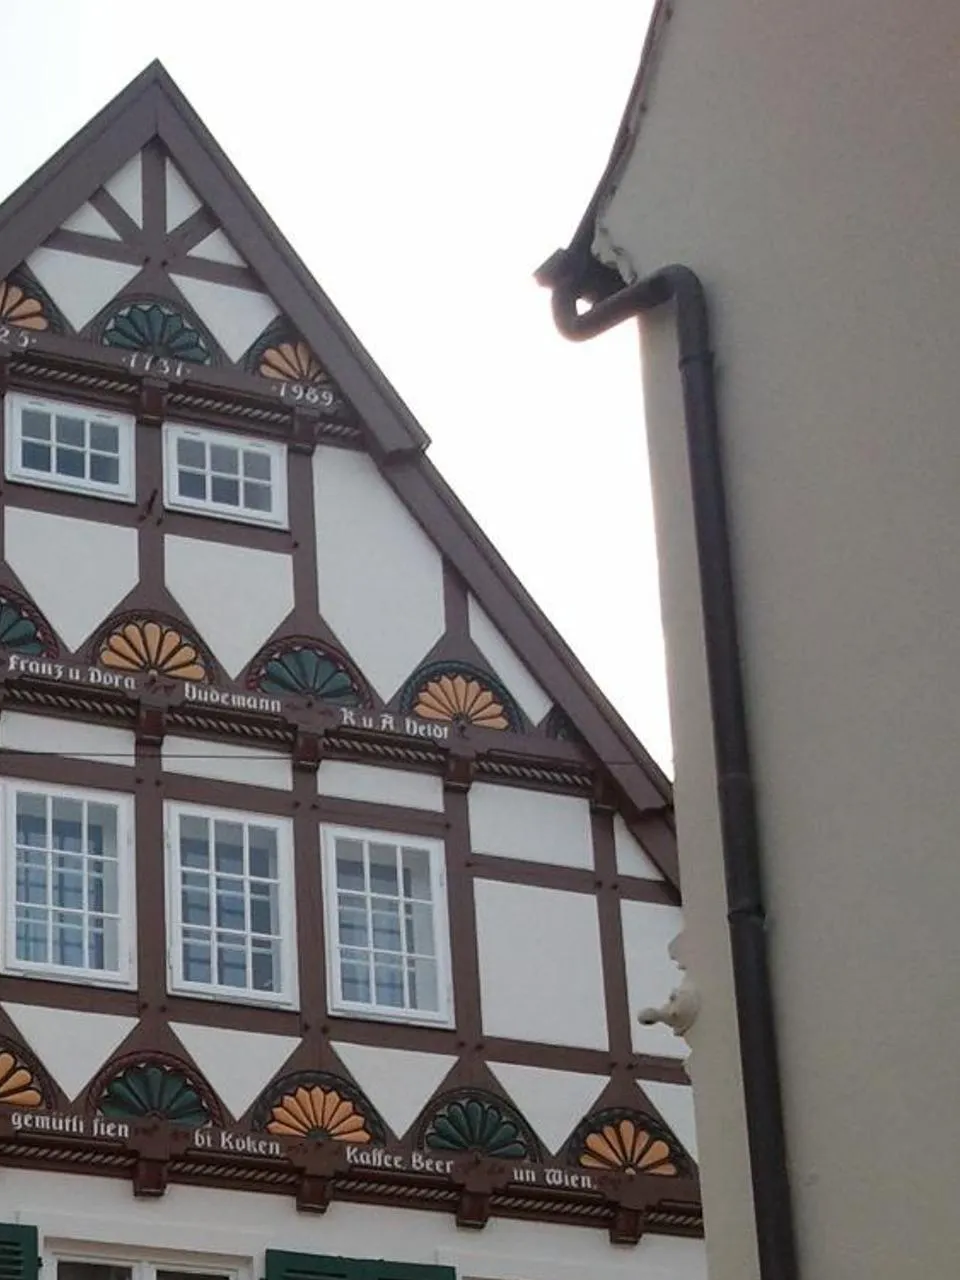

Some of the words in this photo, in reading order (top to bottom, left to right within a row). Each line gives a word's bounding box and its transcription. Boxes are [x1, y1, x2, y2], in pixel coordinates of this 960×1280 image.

[193, 1128, 213, 1148] bi
[410, 1150, 455, 1175] Beer
[512, 1166, 537, 1184] un
